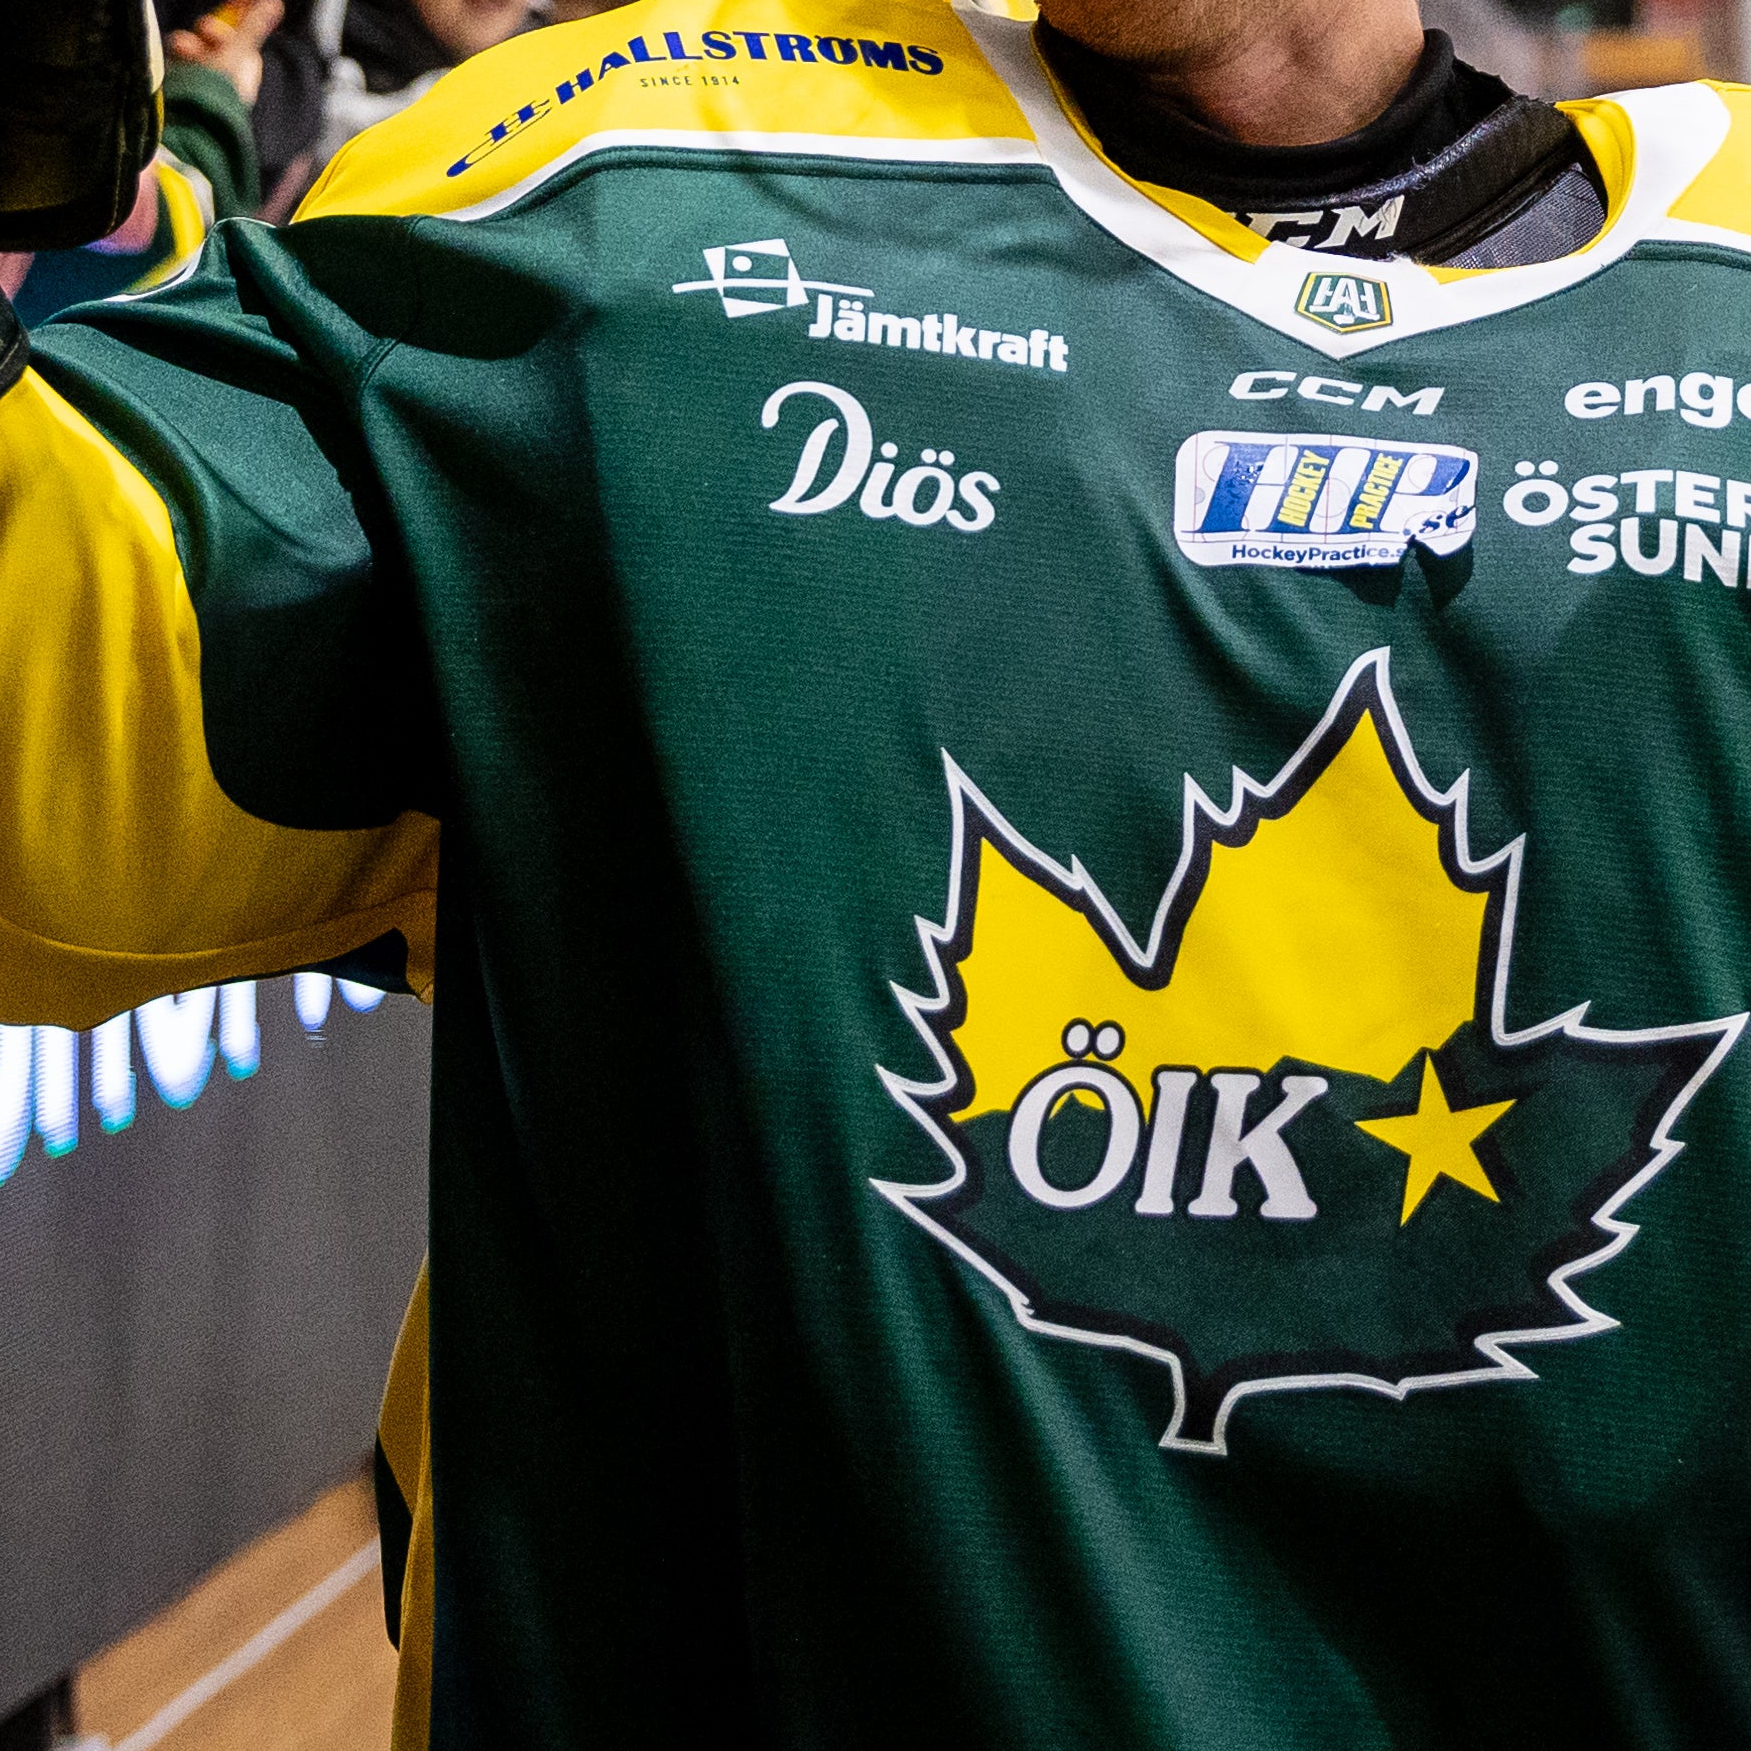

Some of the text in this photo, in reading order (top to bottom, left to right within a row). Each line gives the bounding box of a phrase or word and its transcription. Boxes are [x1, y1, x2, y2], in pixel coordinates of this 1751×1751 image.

[640, 75, 740, 88] SINCE 1914
[1229, 194, 1405, 249] CM
[809, 294, 1069, 372] Jämtkraft
[1229, 371, 1445, 415] CCM
[761, 381, 1001, 533] Diös
[1276, 450, 1330, 527] HOCKEY
[1350, 452, 1403, 530] PRACTICE
[1232, 544, 1404, 563] HockeyPractice.s
[1007, 1018, 1329, 1220] ÖIK
